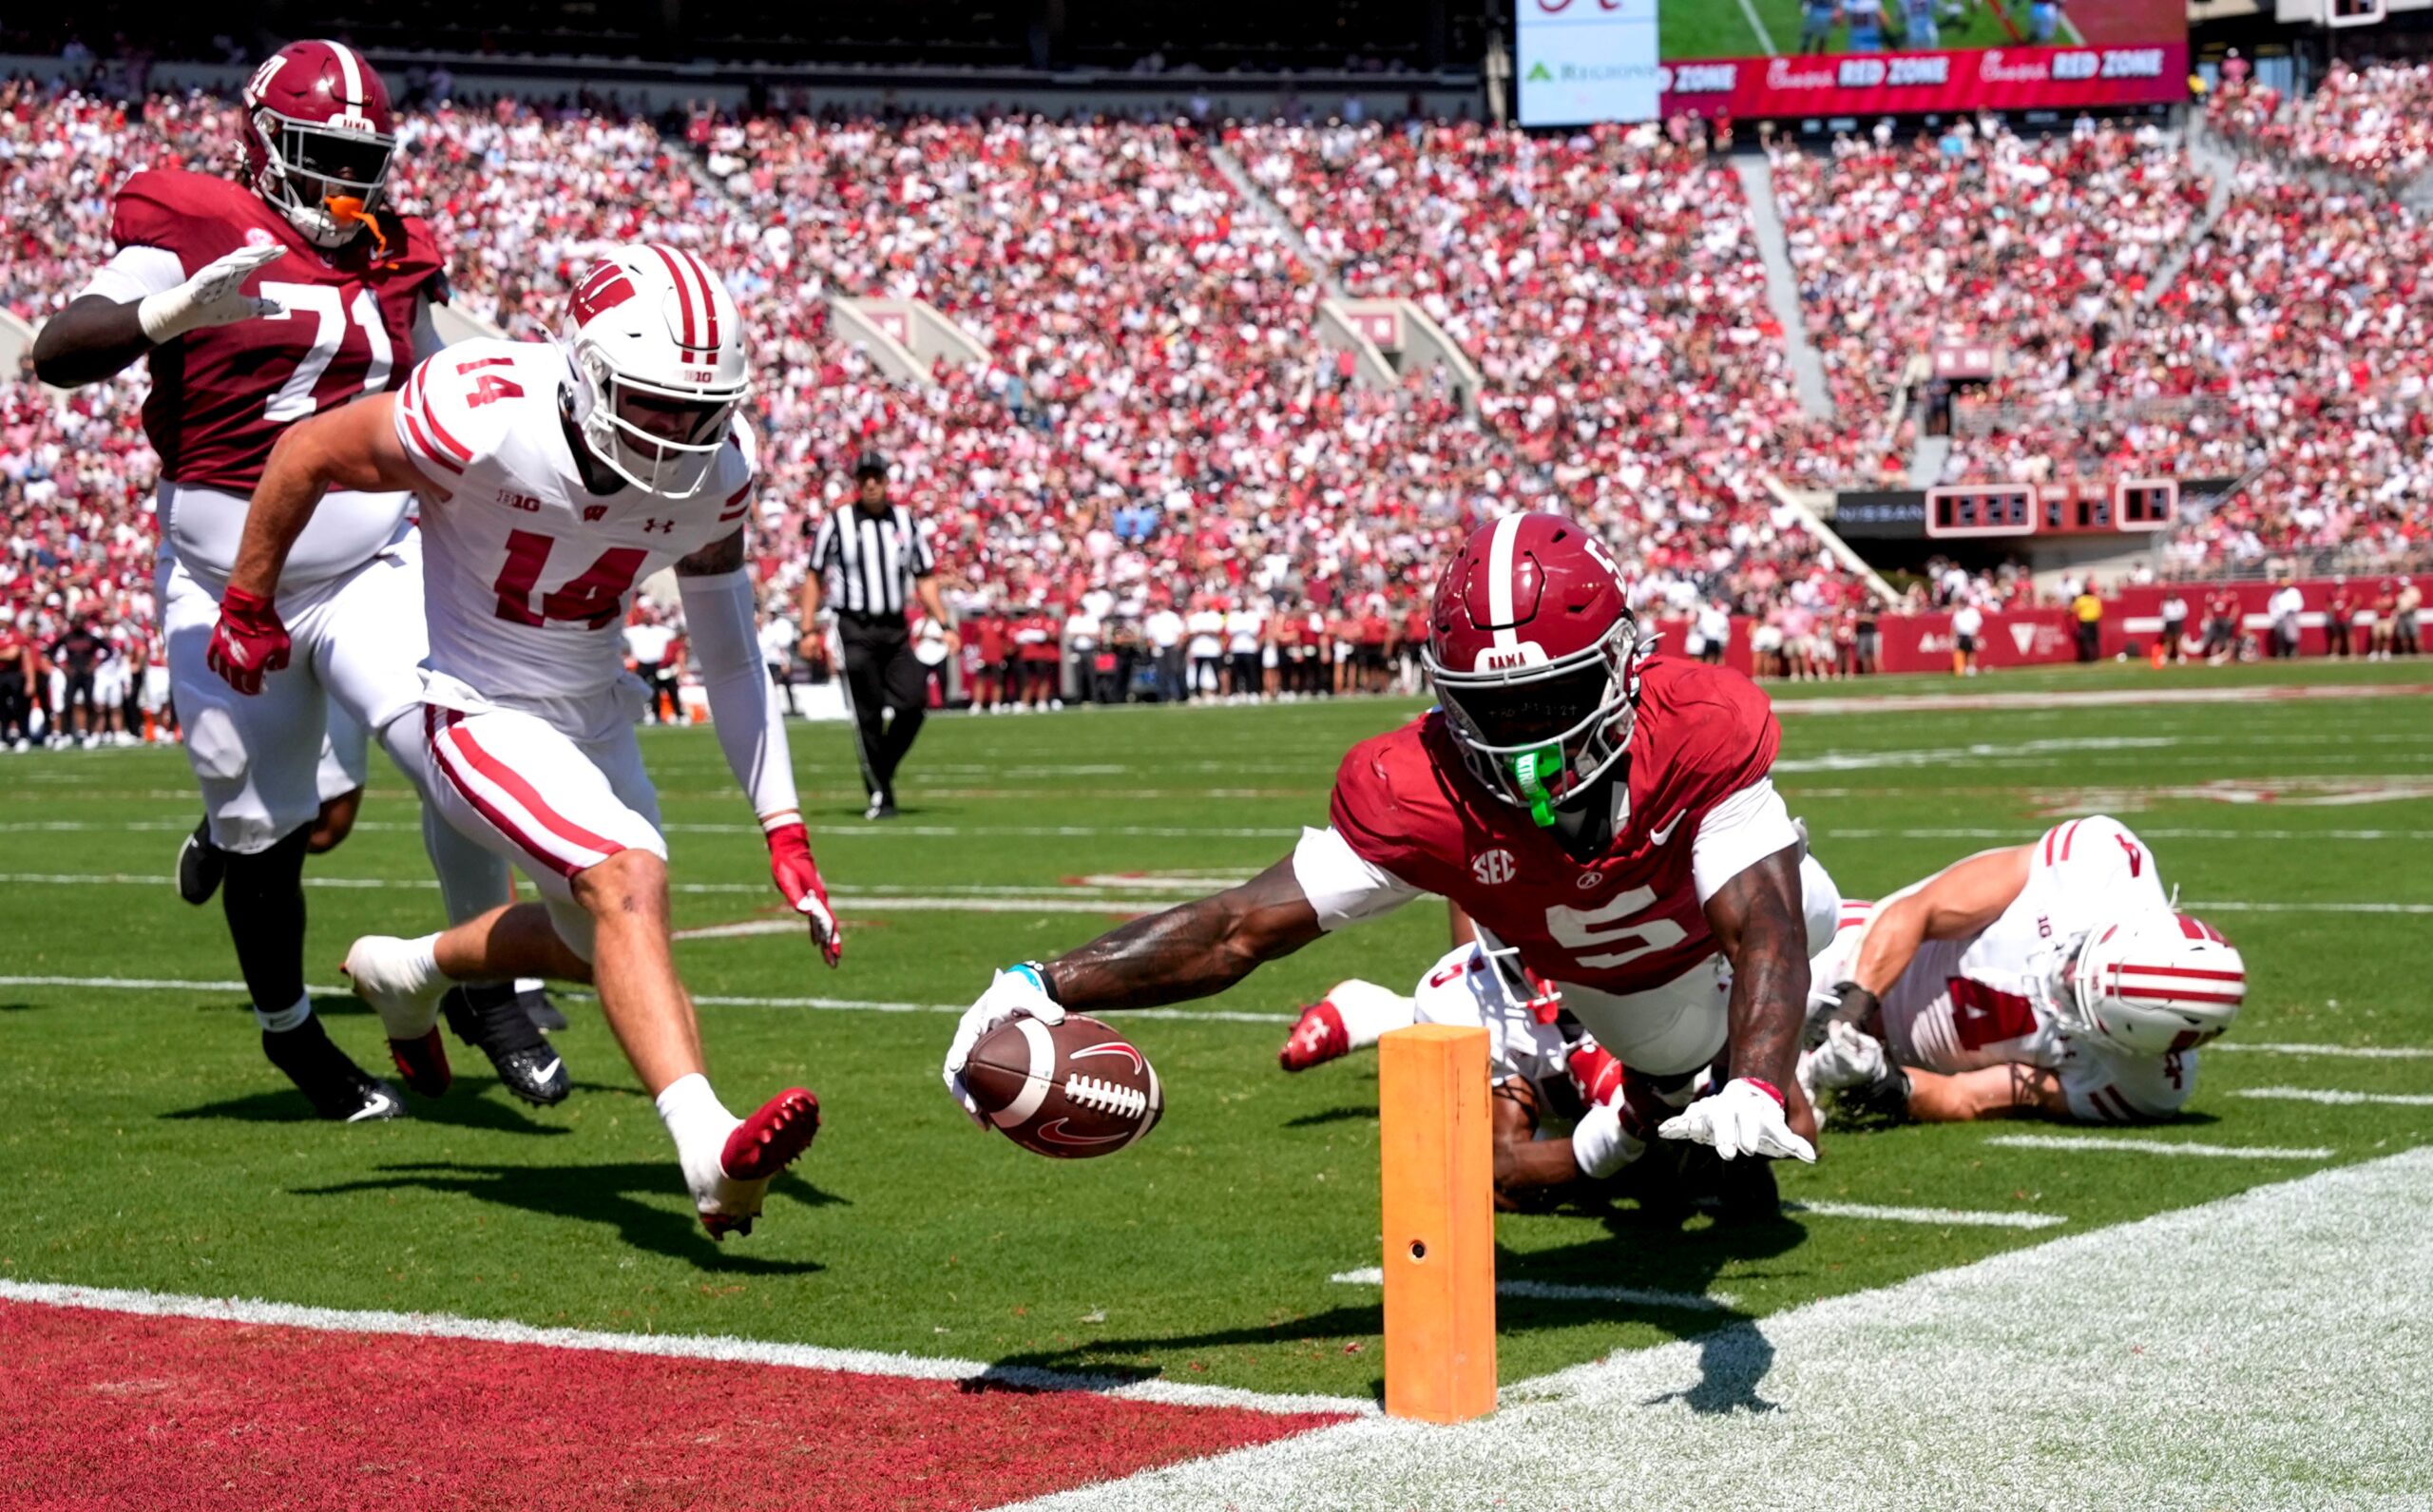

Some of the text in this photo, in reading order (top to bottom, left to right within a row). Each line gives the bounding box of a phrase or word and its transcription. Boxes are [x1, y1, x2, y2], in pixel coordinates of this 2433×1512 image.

[1838, 59, 1887, 87] RED
[1886, 56, 1949, 86] ZONE
[2052, 51, 2099, 80] RED
[2100, 48, 2164, 78] ZONE
[259, 280, 394, 423] 71
[455, 356, 526, 410] 14
[493, 528, 650, 632] 14
[1487, 651, 1528, 671] BAMA
[1472, 848, 1517, 886] SEC
[1544, 884, 1689, 969] 5
[1946, 976, 2039, 1052] 4
